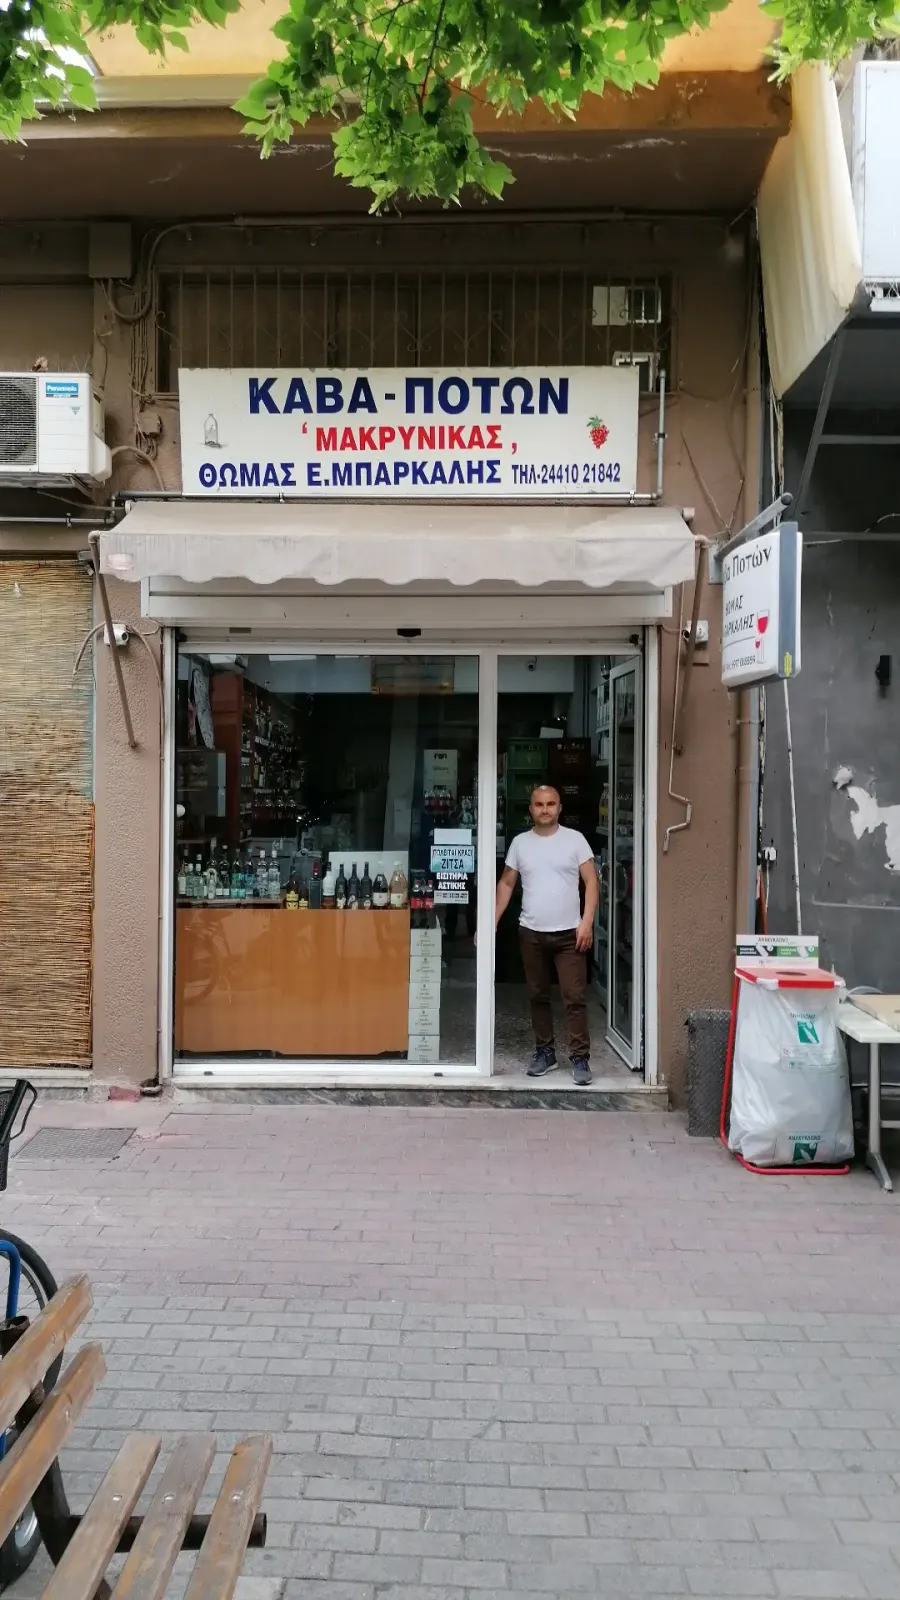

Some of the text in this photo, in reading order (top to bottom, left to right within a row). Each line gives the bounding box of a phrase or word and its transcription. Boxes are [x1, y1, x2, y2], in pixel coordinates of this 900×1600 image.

[199, 462, 297, 487] ΘΩΜΑΣ
[307, 459, 502, 486] Ε.ΜΠΑΡΚΑΛΗΣ
[582, 462, 621, 484] 21842
[441, 858, 464, 870] ΖΙΤΣΑ
[436, 872, 468, 881] ΕΙΣΙΤΗΡΙΑ
[437, 882, 466, 890] ΑΣΤΙΚΗΣ
